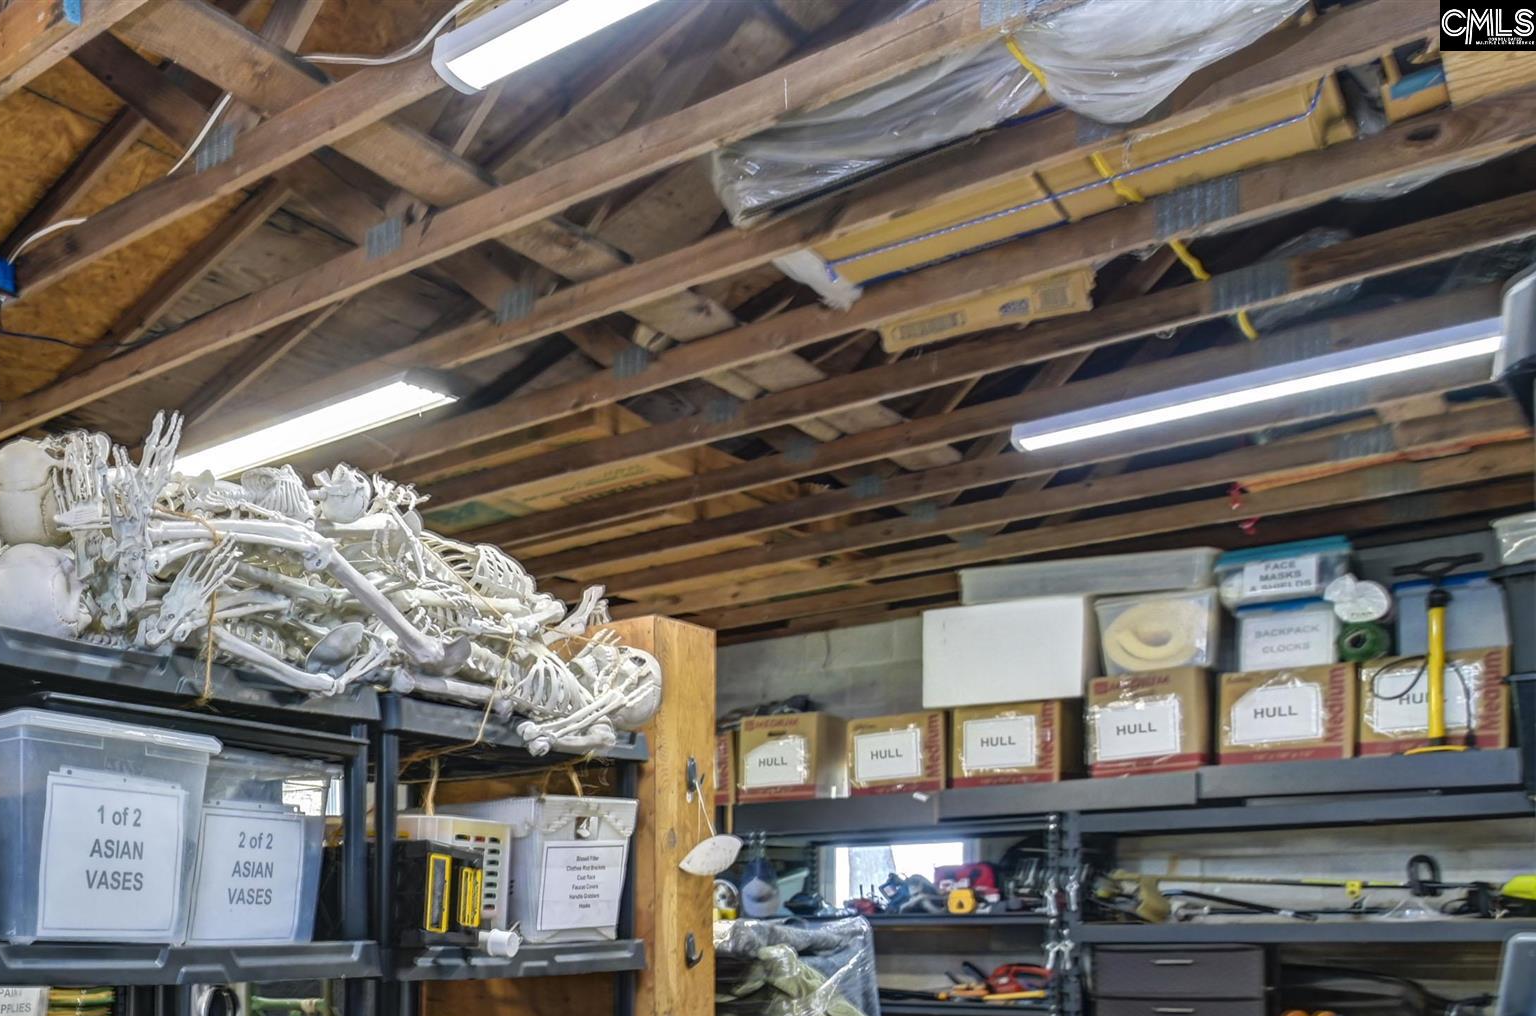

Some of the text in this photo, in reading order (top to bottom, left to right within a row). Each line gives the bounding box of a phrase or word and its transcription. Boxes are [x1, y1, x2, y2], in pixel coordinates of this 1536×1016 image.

[1258, 569, 1302, 583] MASKS
[1254, 623, 1320, 639] BACKPACK
[1253, 705, 1299, 719] HULL
[1116, 722, 1158, 736] HULL
[980, 736, 1016, 748] HULL
[758, 757, 788, 768] HULL
[870, 748, 903, 761] HULL
[97, 806, 142, 827] 1 of 2
[238, 831, 273, 850] 2 of 2
[90, 838, 144, 860] ASIAN
[232, 861, 274, 879] ASIAN
[85, 870, 144, 892] VASES
[227, 887, 273, 906] VASES
